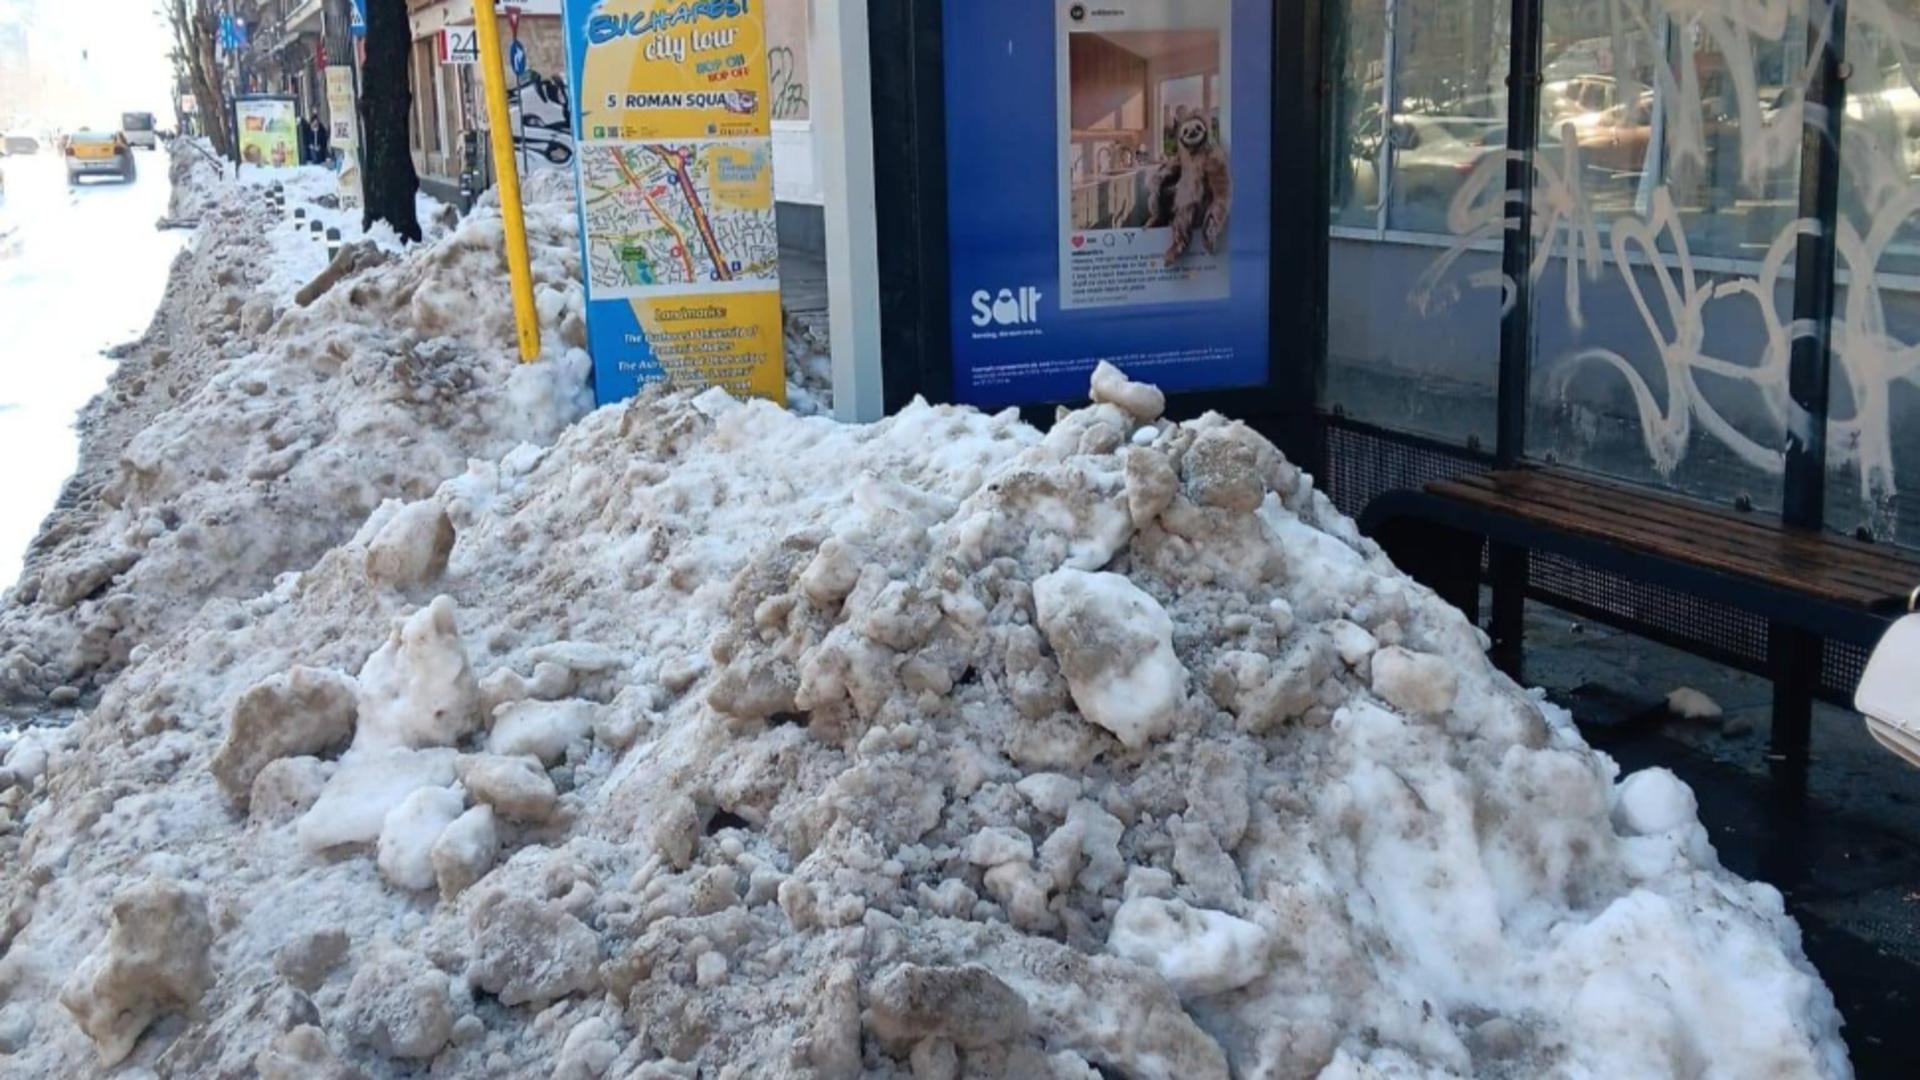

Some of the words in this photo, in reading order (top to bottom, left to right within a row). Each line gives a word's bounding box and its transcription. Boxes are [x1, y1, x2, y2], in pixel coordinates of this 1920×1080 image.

[451, 30, 480, 60] 24
[644, 33, 685, 63] city
[626, 93, 682, 108] ROMAN
[686, 92, 727, 108] SQUA
